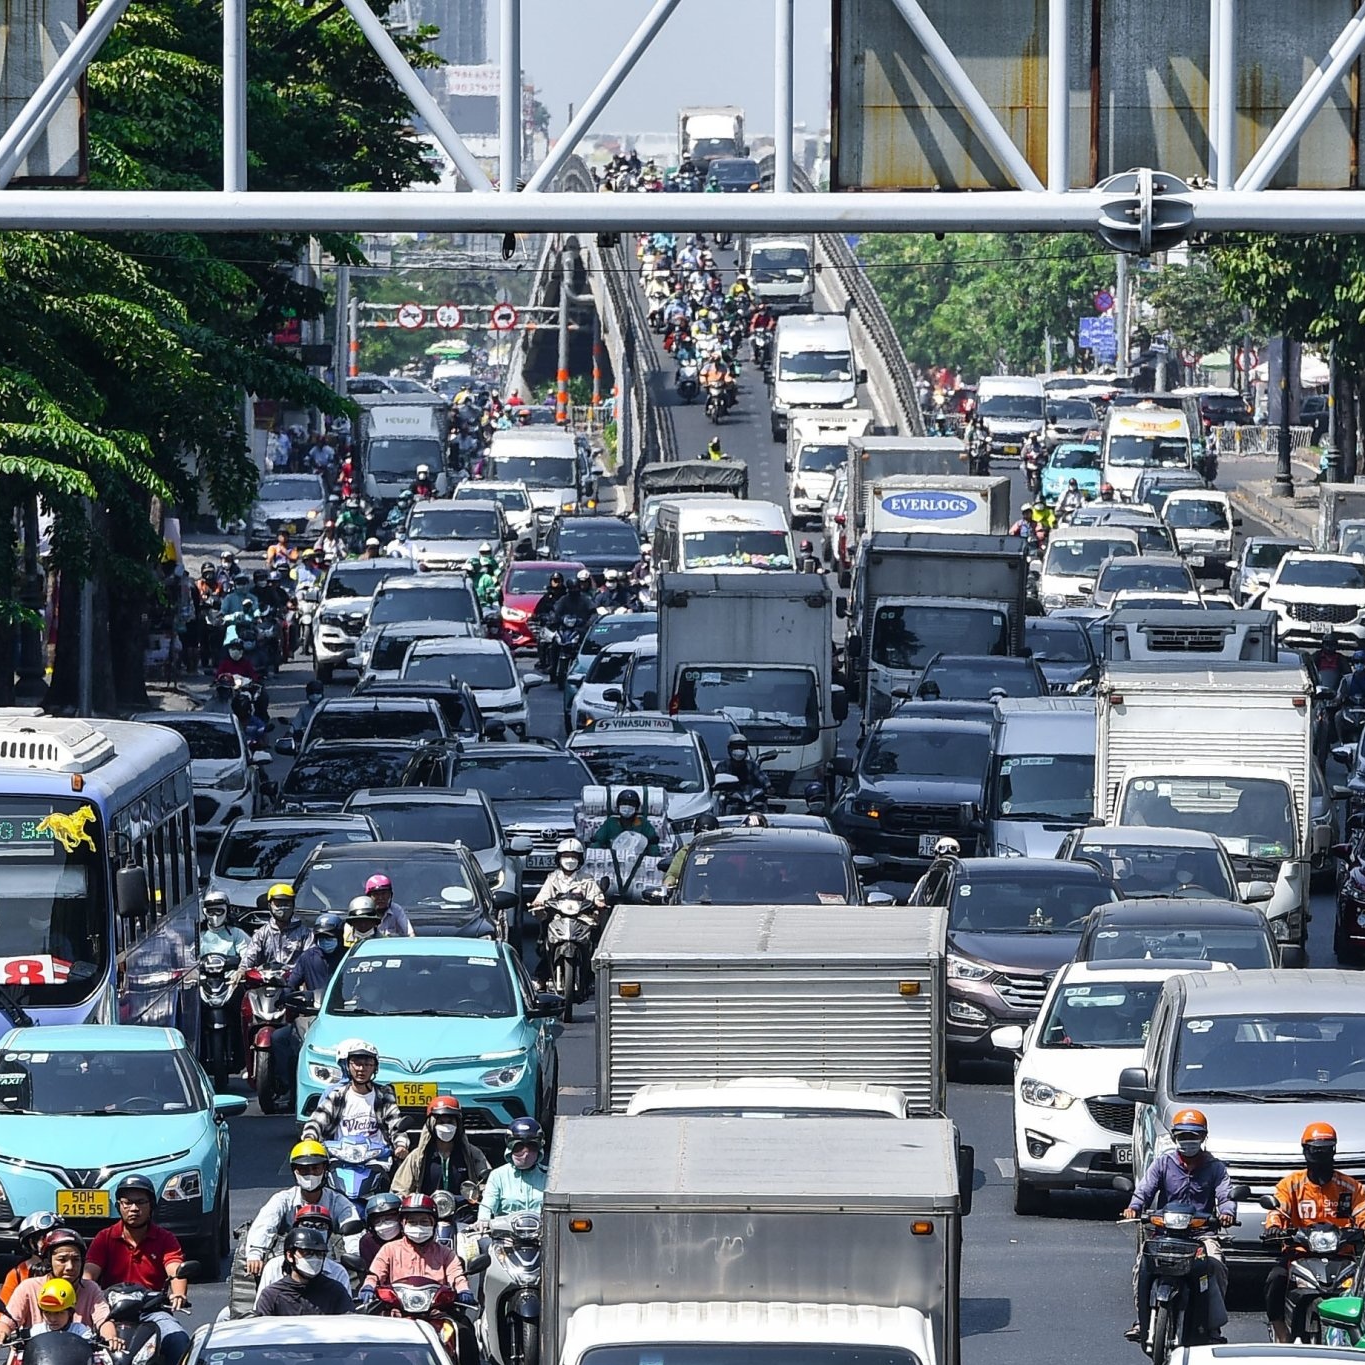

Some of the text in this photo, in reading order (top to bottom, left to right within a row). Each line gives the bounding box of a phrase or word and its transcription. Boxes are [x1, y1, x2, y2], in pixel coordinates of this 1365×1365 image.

[891, 498, 968, 512] EVERLOGS
[612, 719, 652, 728] VINASUN
[4, 959, 47, 984] 8
[403, 1084, 424, 1095] 50E
[72, 1192, 95, 1202] 50H
[62, 1204, 104, 1215] 215.55
